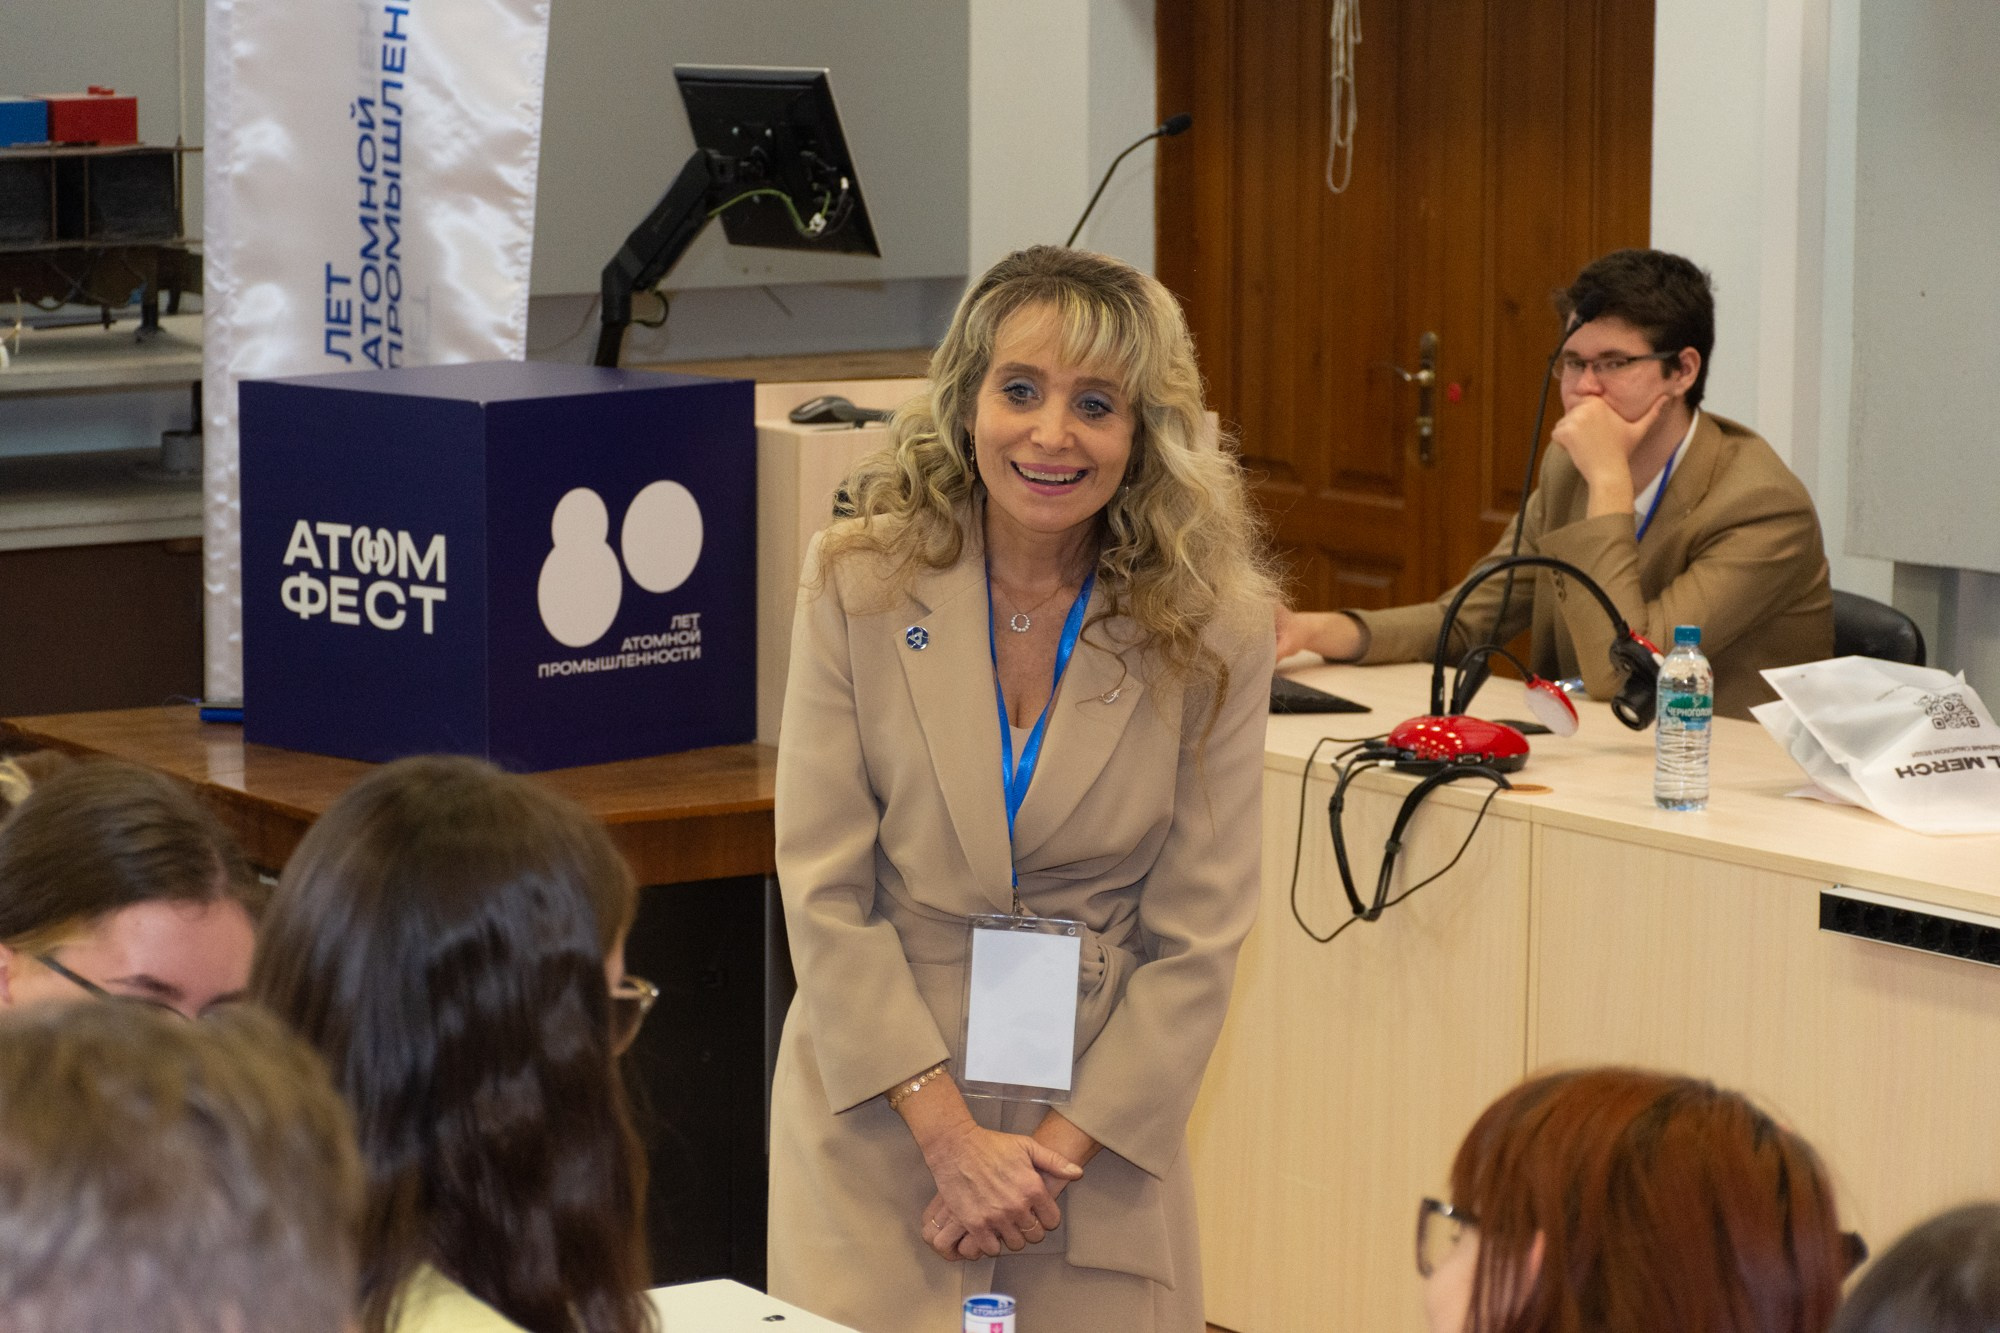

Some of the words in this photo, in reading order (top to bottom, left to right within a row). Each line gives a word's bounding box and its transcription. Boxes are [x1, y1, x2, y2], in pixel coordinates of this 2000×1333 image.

[382, 0, 410, 368] ПРОМЫШЛЕН
[350, 96, 383, 369] АТОМНОЙ
[325, 263, 352, 363] ЛЕТ
[282, 519, 446, 583] АТОМ
[280, 570, 447, 634] ФЕСТ
[670, 613, 701, 630] ЛЕТ
[537, 646, 702, 678] ПРОМЫШЛЕННОСТИ
[620, 627, 701, 652] АТОМНОЙ
[1895, 757, 1985, 778] MERCH
